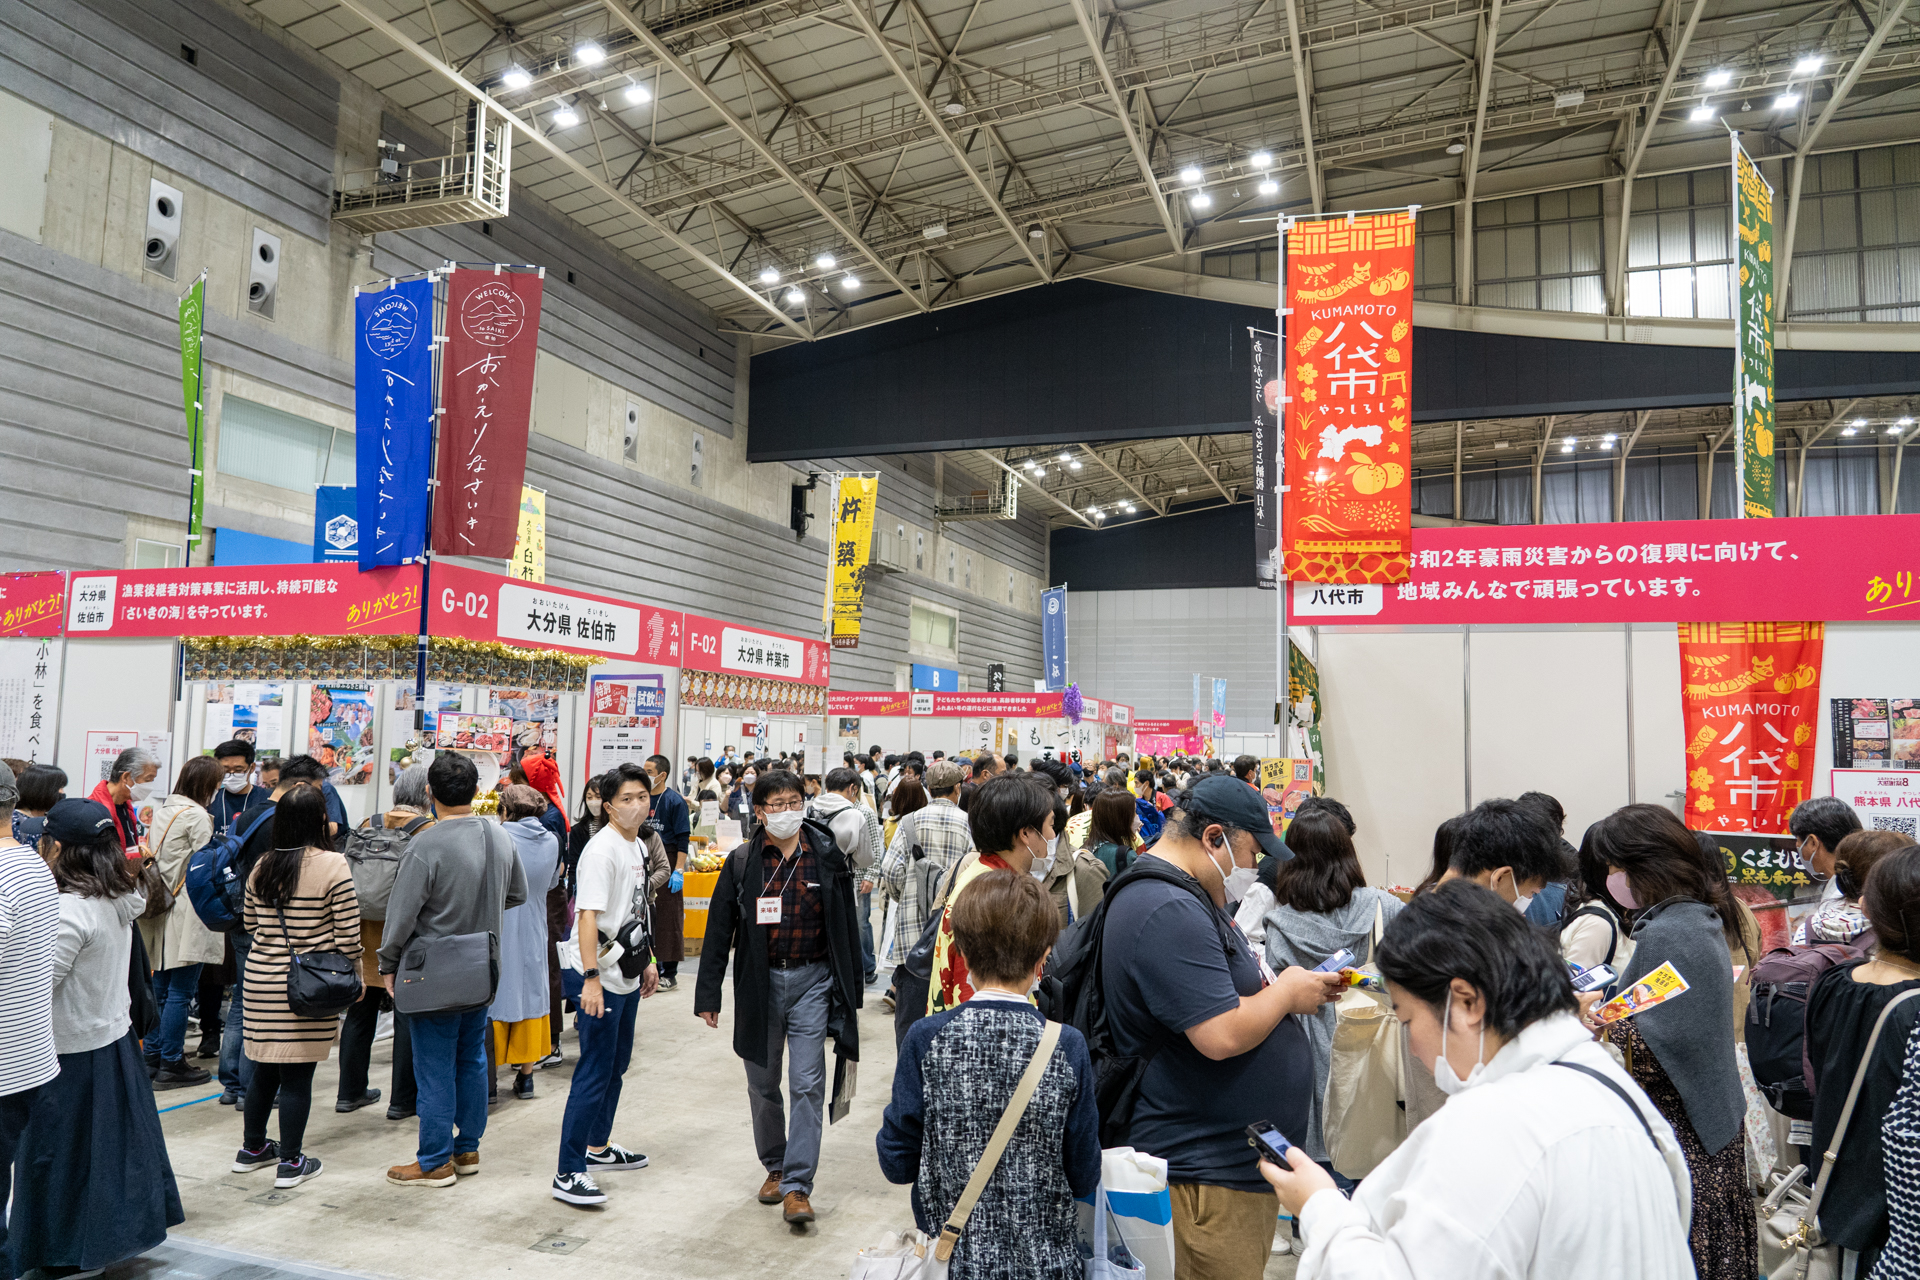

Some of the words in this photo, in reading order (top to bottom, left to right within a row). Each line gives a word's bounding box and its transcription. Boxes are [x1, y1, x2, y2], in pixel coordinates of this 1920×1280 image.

[476, 288, 516, 304] WELCOME
[1311, 304, 1397, 321] KUMAMOTO
[486, 326, 504, 334] SAIKI
[1323, 320, 1384, 400] 八代市
[1318, 402, 1385, 415] やつしろし
[836, 496, 862, 567] 杵築
[521, 546, 536, 582] 臼杵
[80, 590, 106, 602] 大分県
[122, 580, 338, 598] 漁業後継者対策事業に活用し、持続可能な
[1310, 588, 1364, 606] 八代市
[1396, 576, 1700, 602] 地域みんなで頑張っています。
[1866, 571, 1920, 605] あり
[3, 592, 60, 626] ありがとう!
[121, 604, 270, 621] 『さいきの海』を守っています。
[346, 584, 419, 624] ありがとう!
[442, 588, 489, 618] G-02
[532, 598, 570, 611] おおいたけん
[586, 608, 609, 618] さいきし
[78, 612, 104, 624] 佐伯市
[527, 609, 572, 636] 大分県
[577, 616, 616, 644] 佐伯市
[670, 621, 679, 657] 九州
[691, 632, 716, 655] F-02
[738, 646, 763, 666] 大分県
[766, 650, 790, 669] 杵築市
[822, 649, 828, 678] 九州
[933, 670, 940, 687] B
[595, 682, 611, 698] 特別
[597, 695, 613, 712] 販売
[880, 700, 908, 712] ありがとう!
[1702, 703, 1800, 719] KUMAMOTO
[1719, 721, 1789, 810] 八代市
[1854, 796, 1892, 807] 熊本県
[1741, 867, 1810, 888] 黒毛和牛
